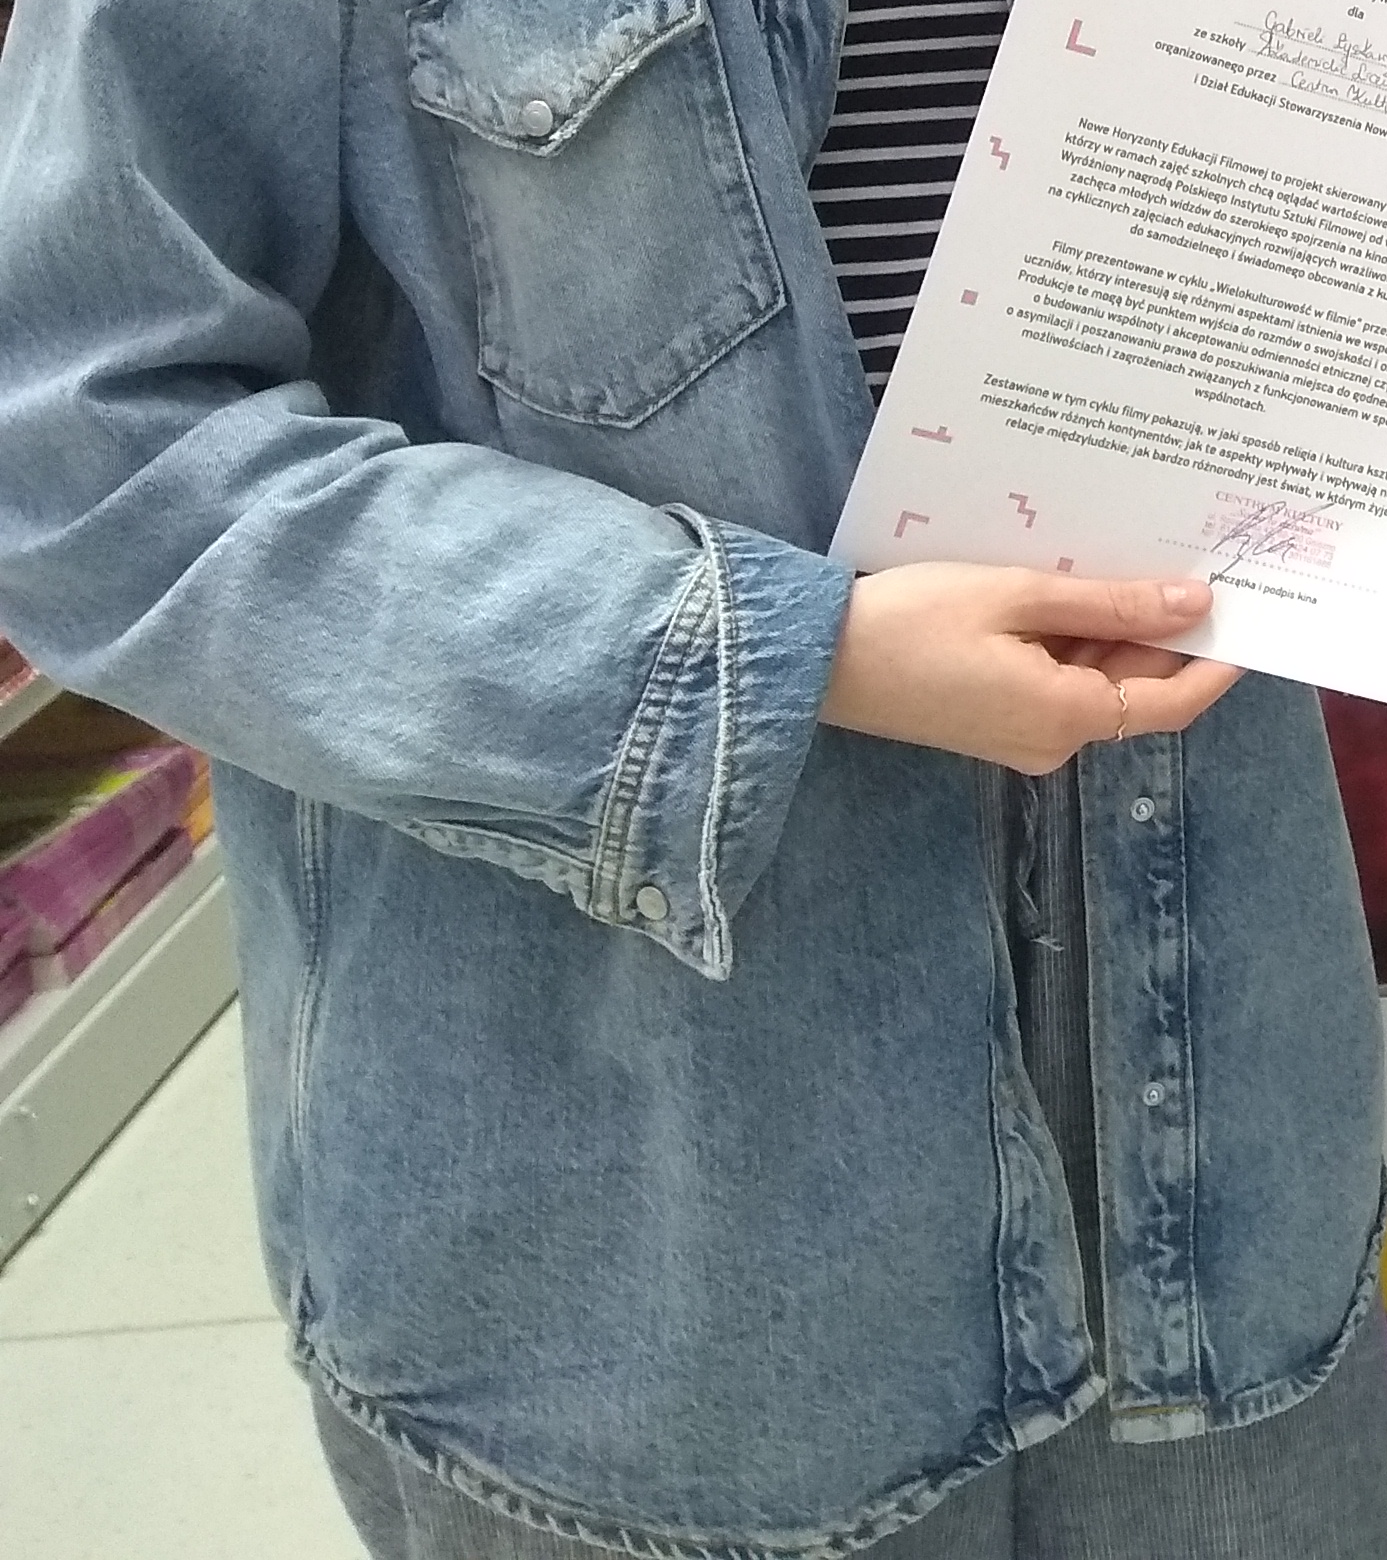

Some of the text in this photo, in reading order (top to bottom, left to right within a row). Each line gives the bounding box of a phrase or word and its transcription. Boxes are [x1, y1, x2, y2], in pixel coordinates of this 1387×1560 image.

[1129, 222, 1145, 237] do
[1145, 228, 1230, 260] samodzielnego
[1230, 248, 1237, 261] i
[1236, 250, 1306, 280] świadomego
[1306, 269, 1367, 295] obcowania
[1366, 286, 1376, 298] z
[1263, 584, 1295, 600] podpis
[1297, 591, 1317, 604] kina
